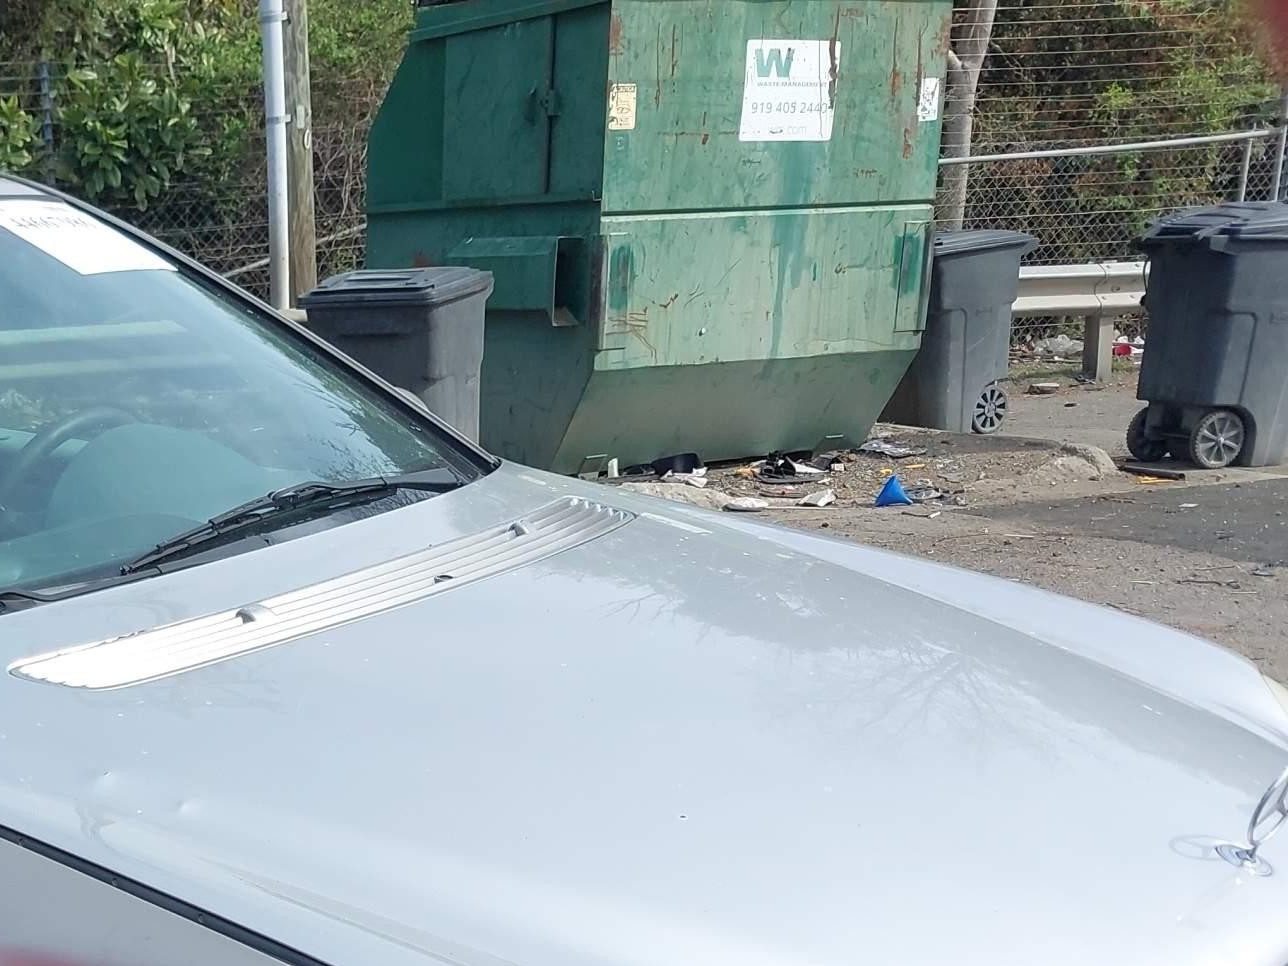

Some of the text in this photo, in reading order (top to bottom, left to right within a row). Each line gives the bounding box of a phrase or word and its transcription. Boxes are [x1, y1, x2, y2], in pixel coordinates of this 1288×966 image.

[751, 102, 828, 114] 919 405 2440
